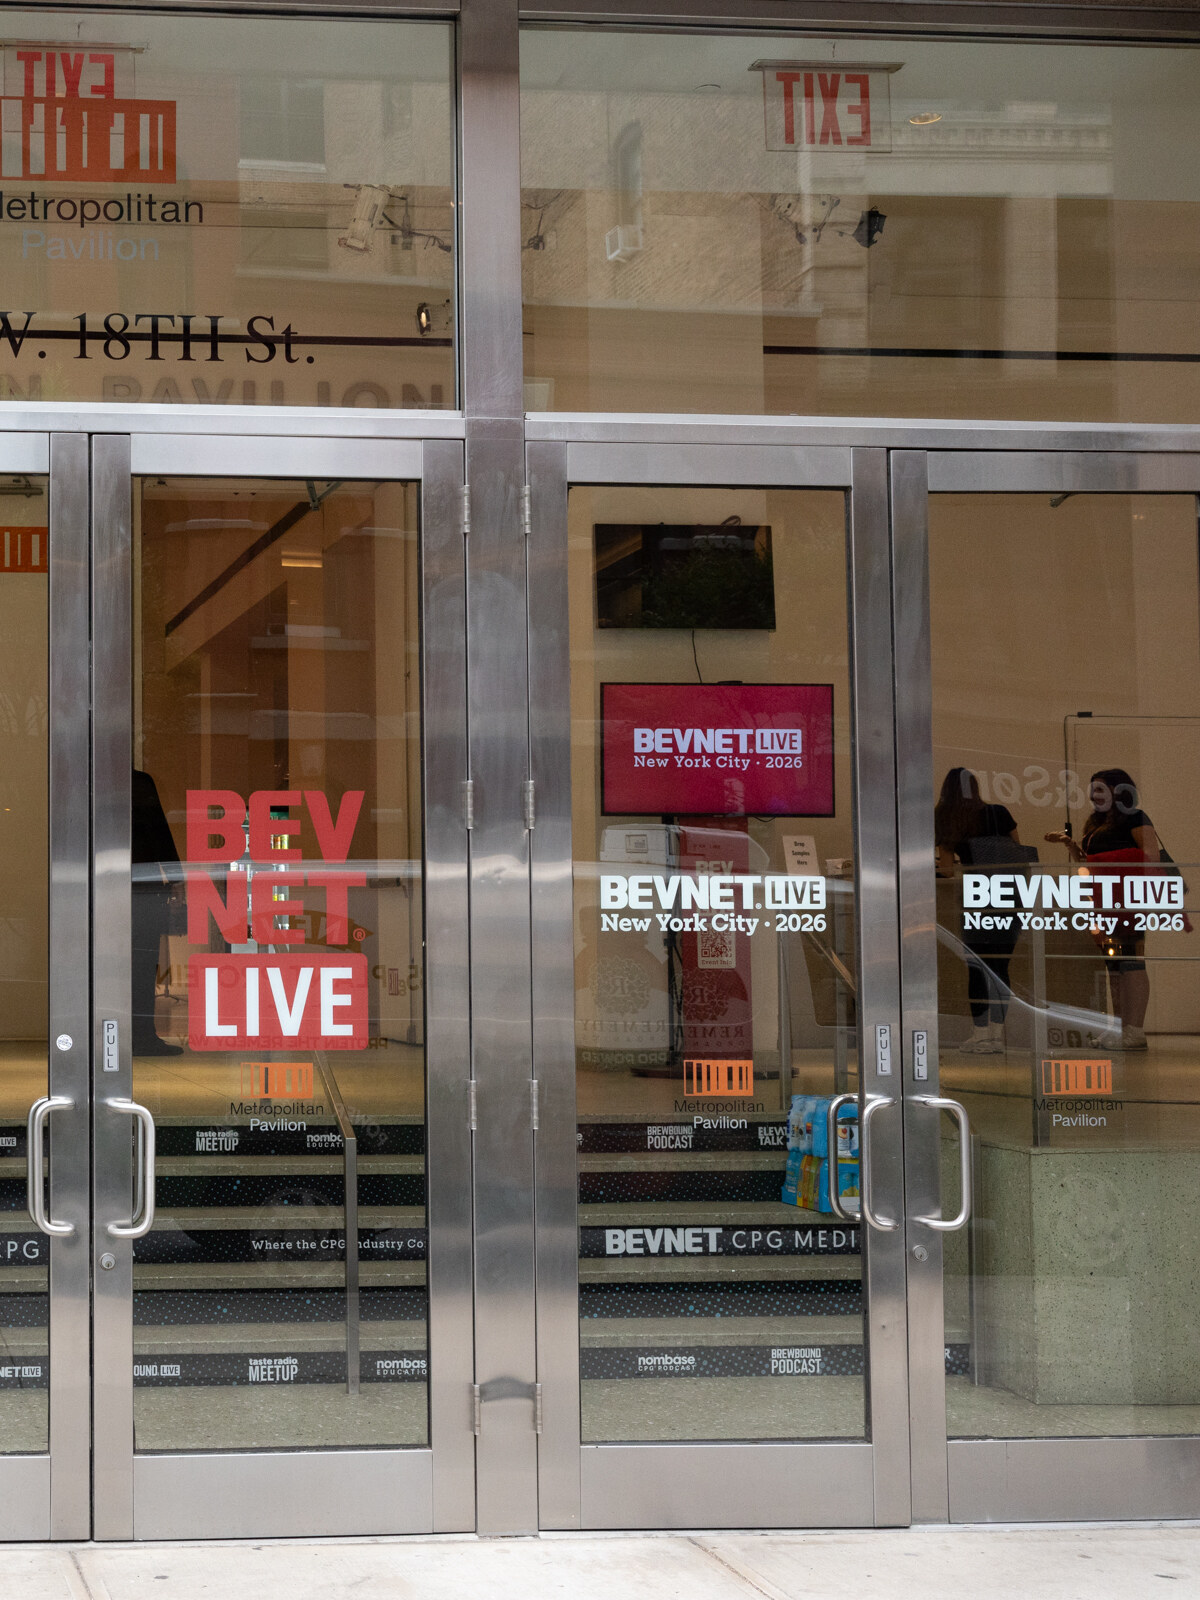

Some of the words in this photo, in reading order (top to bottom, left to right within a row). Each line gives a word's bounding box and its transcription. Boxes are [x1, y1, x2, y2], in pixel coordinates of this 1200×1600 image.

[21, 229, 160, 262] Pavilion
[72, 312, 225, 362] 18TH
[245, 315, 316, 364] St.
[634, 728, 754, 754] BEVNET
[761, 733, 798, 750] LIVE
[634, 755, 668, 767] New
[675, 755, 710, 768] York
[716, 756, 750, 770] City
[766, 756, 802, 769] 2026
[186, 789, 365, 864] BEV
[600, 875, 762, 910] BEVNET
[770, 880, 821, 905] LIVE
[963, 874, 1121, 909] BEVNET
[1128, 880, 1179, 904] LIVE
[186, 870, 367, 945] NET
[601, 914, 651, 932] New
[655, 914, 707, 932] York
[711, 913, 760, 936] City
[775, 914, 826, 932] 2026
[963, 912, 1013, 930] New
[1017, 912, 1068, 930] York
[1071, 912, 1118, 935] City
[1134, 913, 1184, 931] 2026
[204, 967, 354, 1037] LIVE
[105, 1022, 115, 1068] PULL
[879, 1028, 888, 1073] PULL
[916, 1034, 925, 1078] PULL
[230, 1102, 325, 1118] Metropolitan
[674, 1100, 765, 1115] Metropolitan
[1033, 1099, 1123, 1114] Metropolitan
[249, 1119, 307, 1132] Pavilion
[693, 1116, 748, 1129] Pavilion
[1052, 1115, 1107, 1127] Pavilion
[647, 1126, 693, 1135] BREWBOUND
[1, 1138, 15, 1146] LIVE
[196, 1138, 239, 1151] MEETUP
[647, 1135, 693, 1149] PODCAST
[759, 1136, 784, 1146] TALK
[252, 1240, 293, 1250] Where
[296, 1239, 318, 1249] the
[320, 1239, 345, 1249] CPG
[357, 1239, 404, 1251] ndustry
[605, 1227, 722, 1254] BEVNET
[732, 1230, 783, 1249] CPG
[249, 1358, 272, 1366] taste
[273, 1357, 298, 1365] radio
[638, 1355, 695, 1366] nombase
[771, 1349, 821, 1359] BREWBOUND
[23, 1367, 40, 1377] LIVE
[162, 1366, 179, 1375] LIVE
[249, 1365, 298, 1381] MEETUP
[771, 1359, 822, 1374] PODCAST
